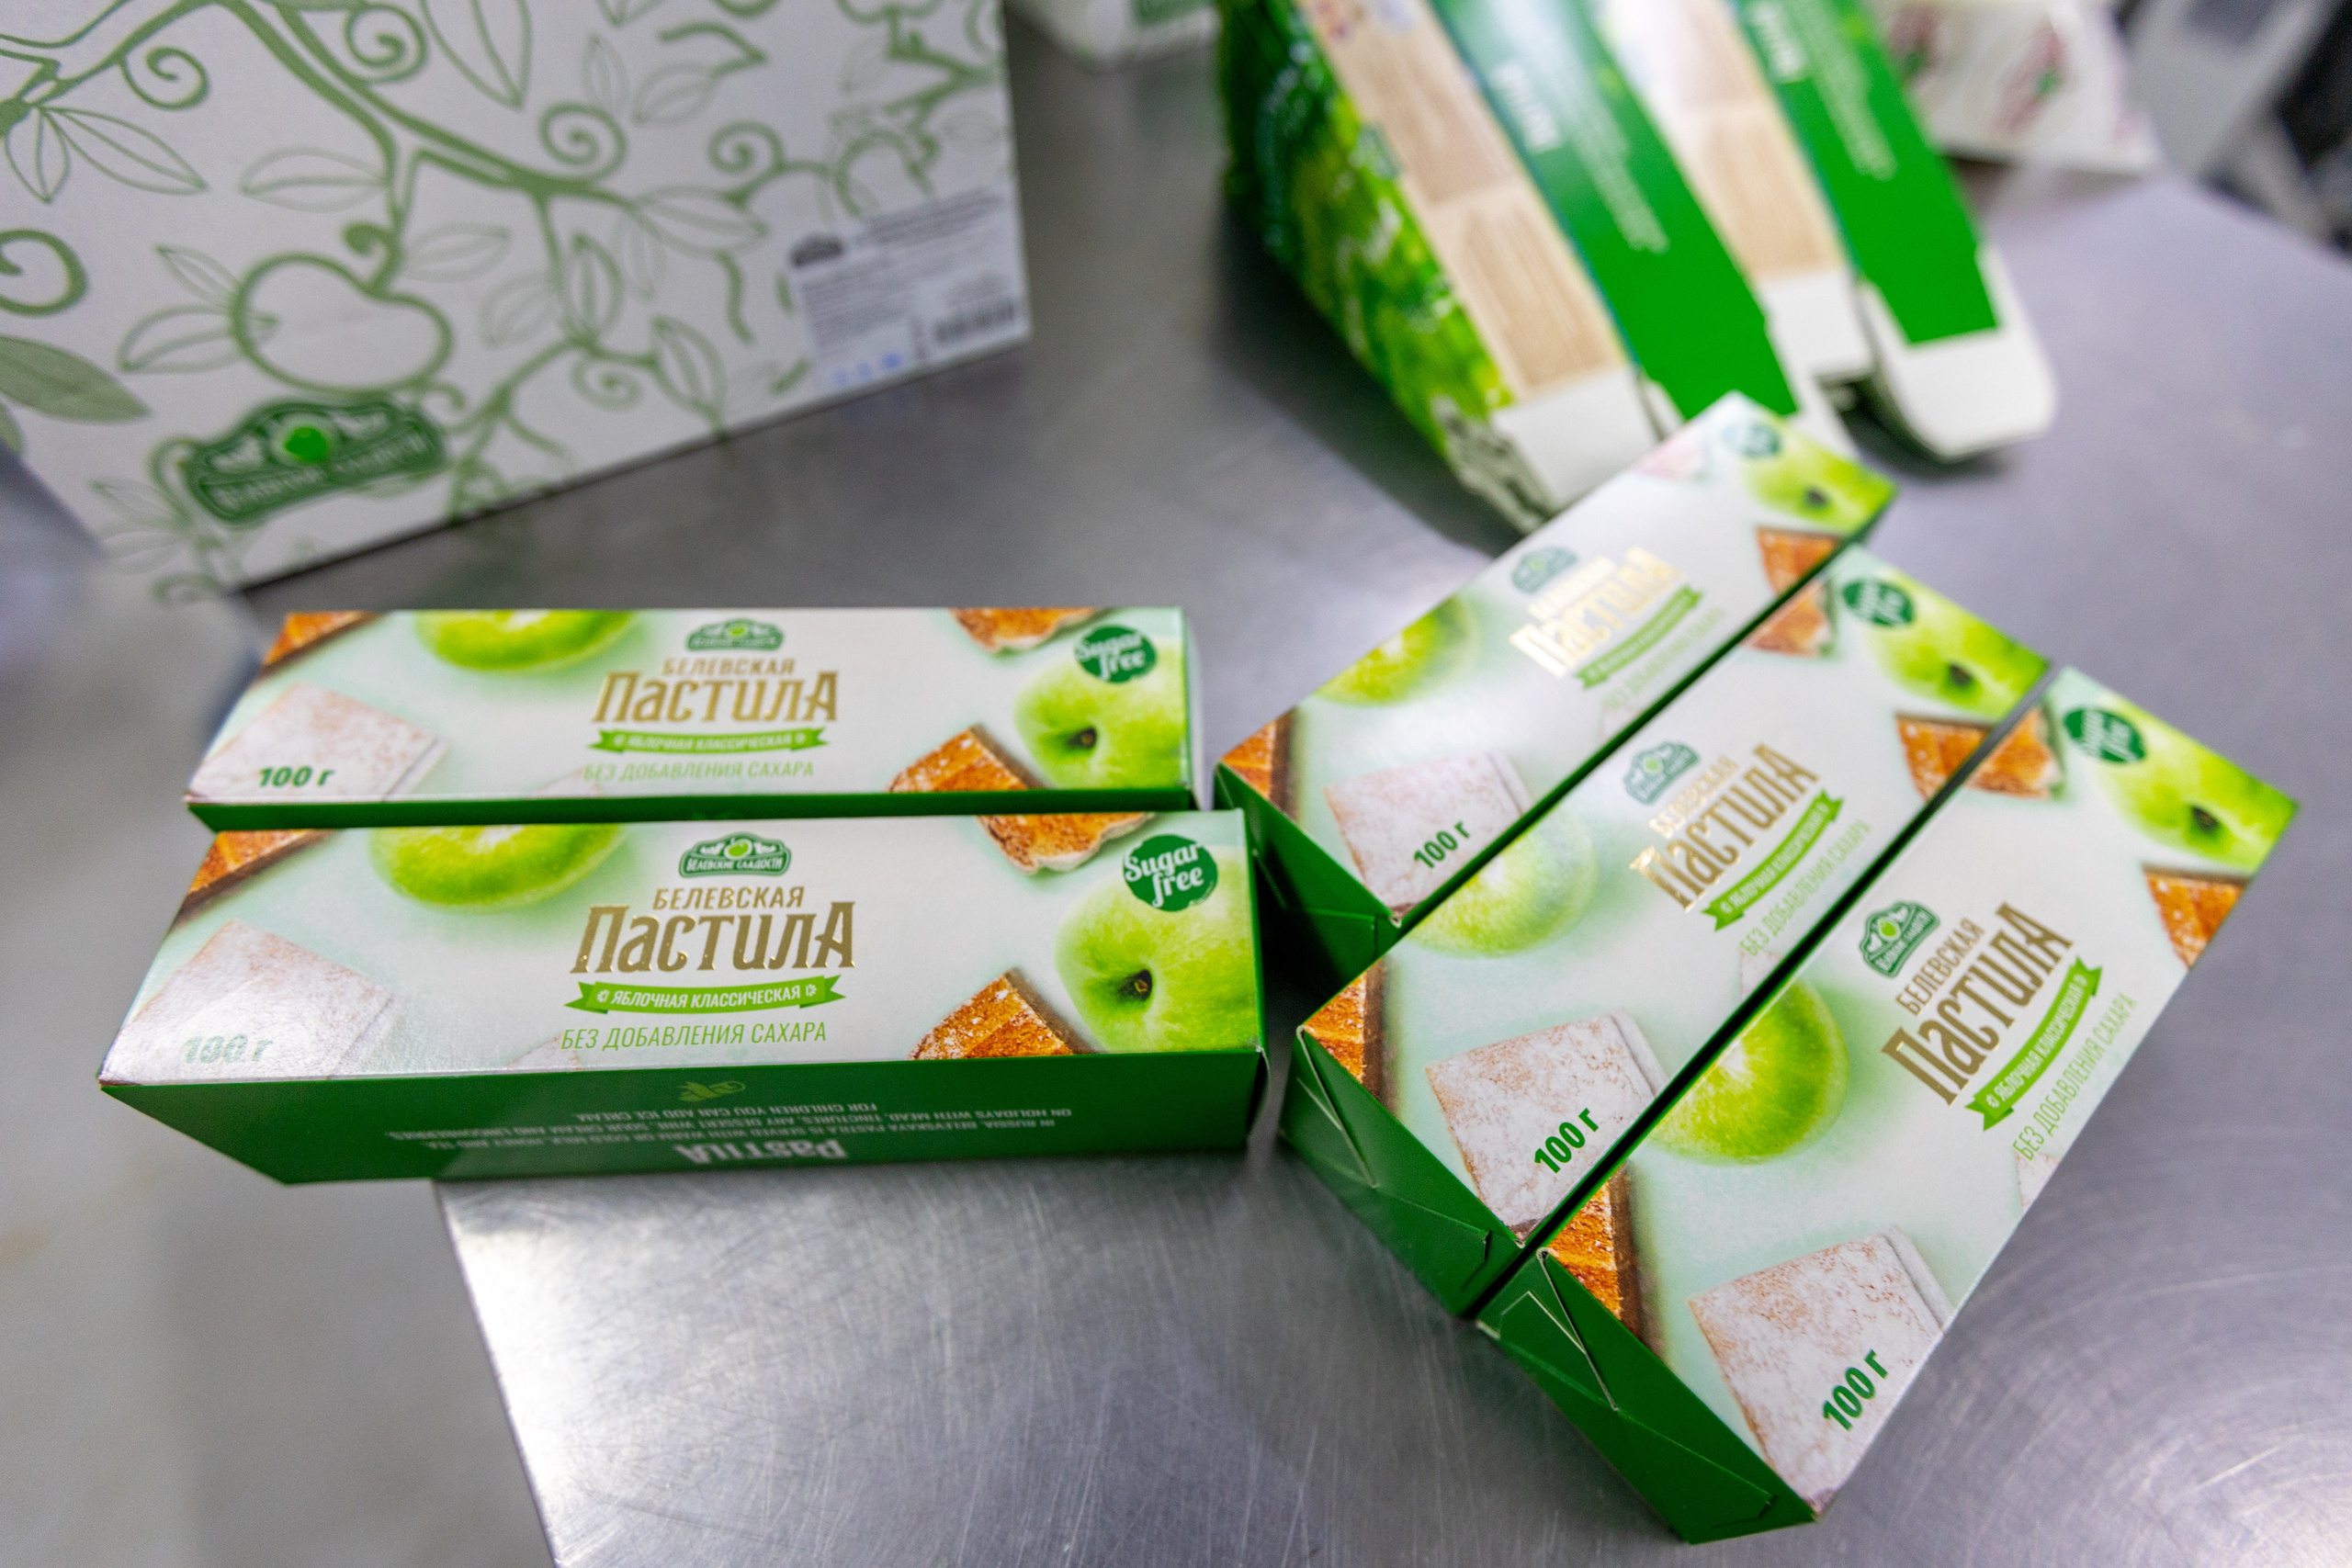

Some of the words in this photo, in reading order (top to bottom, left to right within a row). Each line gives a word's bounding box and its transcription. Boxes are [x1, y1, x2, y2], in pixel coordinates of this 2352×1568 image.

[662, 658, 795, 676] БЕЛЕВСКАЯ
[259, 766, 311, 787] 100
[583, 763, 615, 780] БЕЗ
[619, 762, 741, 781] ДОБАВЛЕНИЯ
[747, 761, 813, 778] САХАРА
[1124, 844, 1204, 882] Sugar
[1413, 830, 1459, 869] 100
[651, 886, 805, 910] БЕЛЕВСКАЯ
[1151, 866, 1204, 908] free
[1895, 917, 1985, 1017] БЕЛЕВСКАЯ
[610, 989, 688, 1010] ЯБЛОЧНАЯ
[691, 985, 800, 1009] КЛАССИЧЕСКАЯ
[184, 1034, 246, 1064] 100
[560, 1028, 599, 1049] БЕЗ
[602, 1023, 745, 1052] ДОБАВЛЕНИЯ
[751, 1021, 826, 1043] САХАРА
[1993, 1049, 2044, 1102] ЯБЛОЧНАЯ
[2012, 1125, 2045, 1161] БЕЗ
[2033, 1037, 2107, 1137] ДОБАВЛЕНИЯ
[2092, 993, 2138, 1054] САХАРА
[1534, 1122, 1586, 1174] 100
[1822, 1366, 1876, 1432] 100
